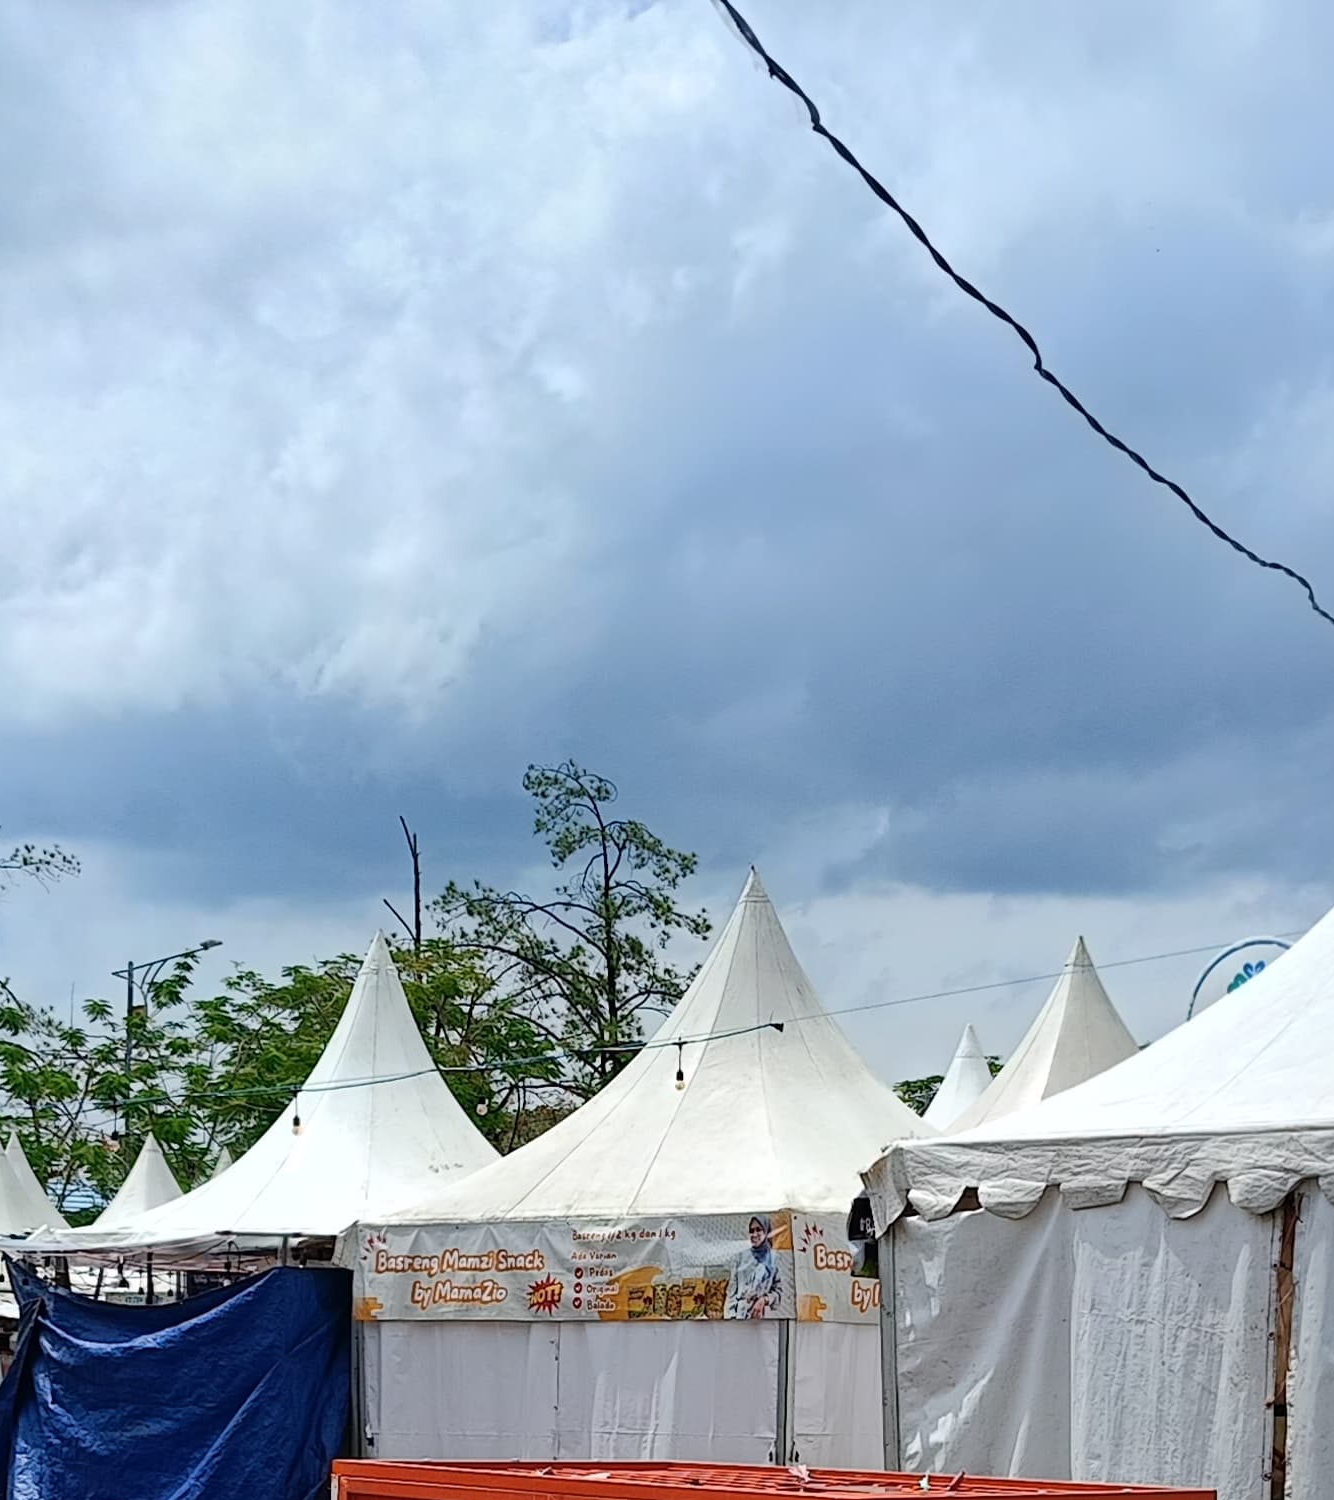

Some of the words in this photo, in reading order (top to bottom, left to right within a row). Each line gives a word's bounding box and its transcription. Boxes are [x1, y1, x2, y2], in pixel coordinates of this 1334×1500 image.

[624, 1228, 636, 1242] kg
[639, 1228, 657, 1240] dan
[665, 1228, 676, 1240] kg
[376, 1249, 439, 1277] Basreng
[440, 1248, 494, 1273] Mamzi
[496, 1249, 545, 1272] Snack
[411, 1281, 433, 1310] by
[433, 1279, 507, 1304] MamaZio
[851, 1281, 871, 1312] by
